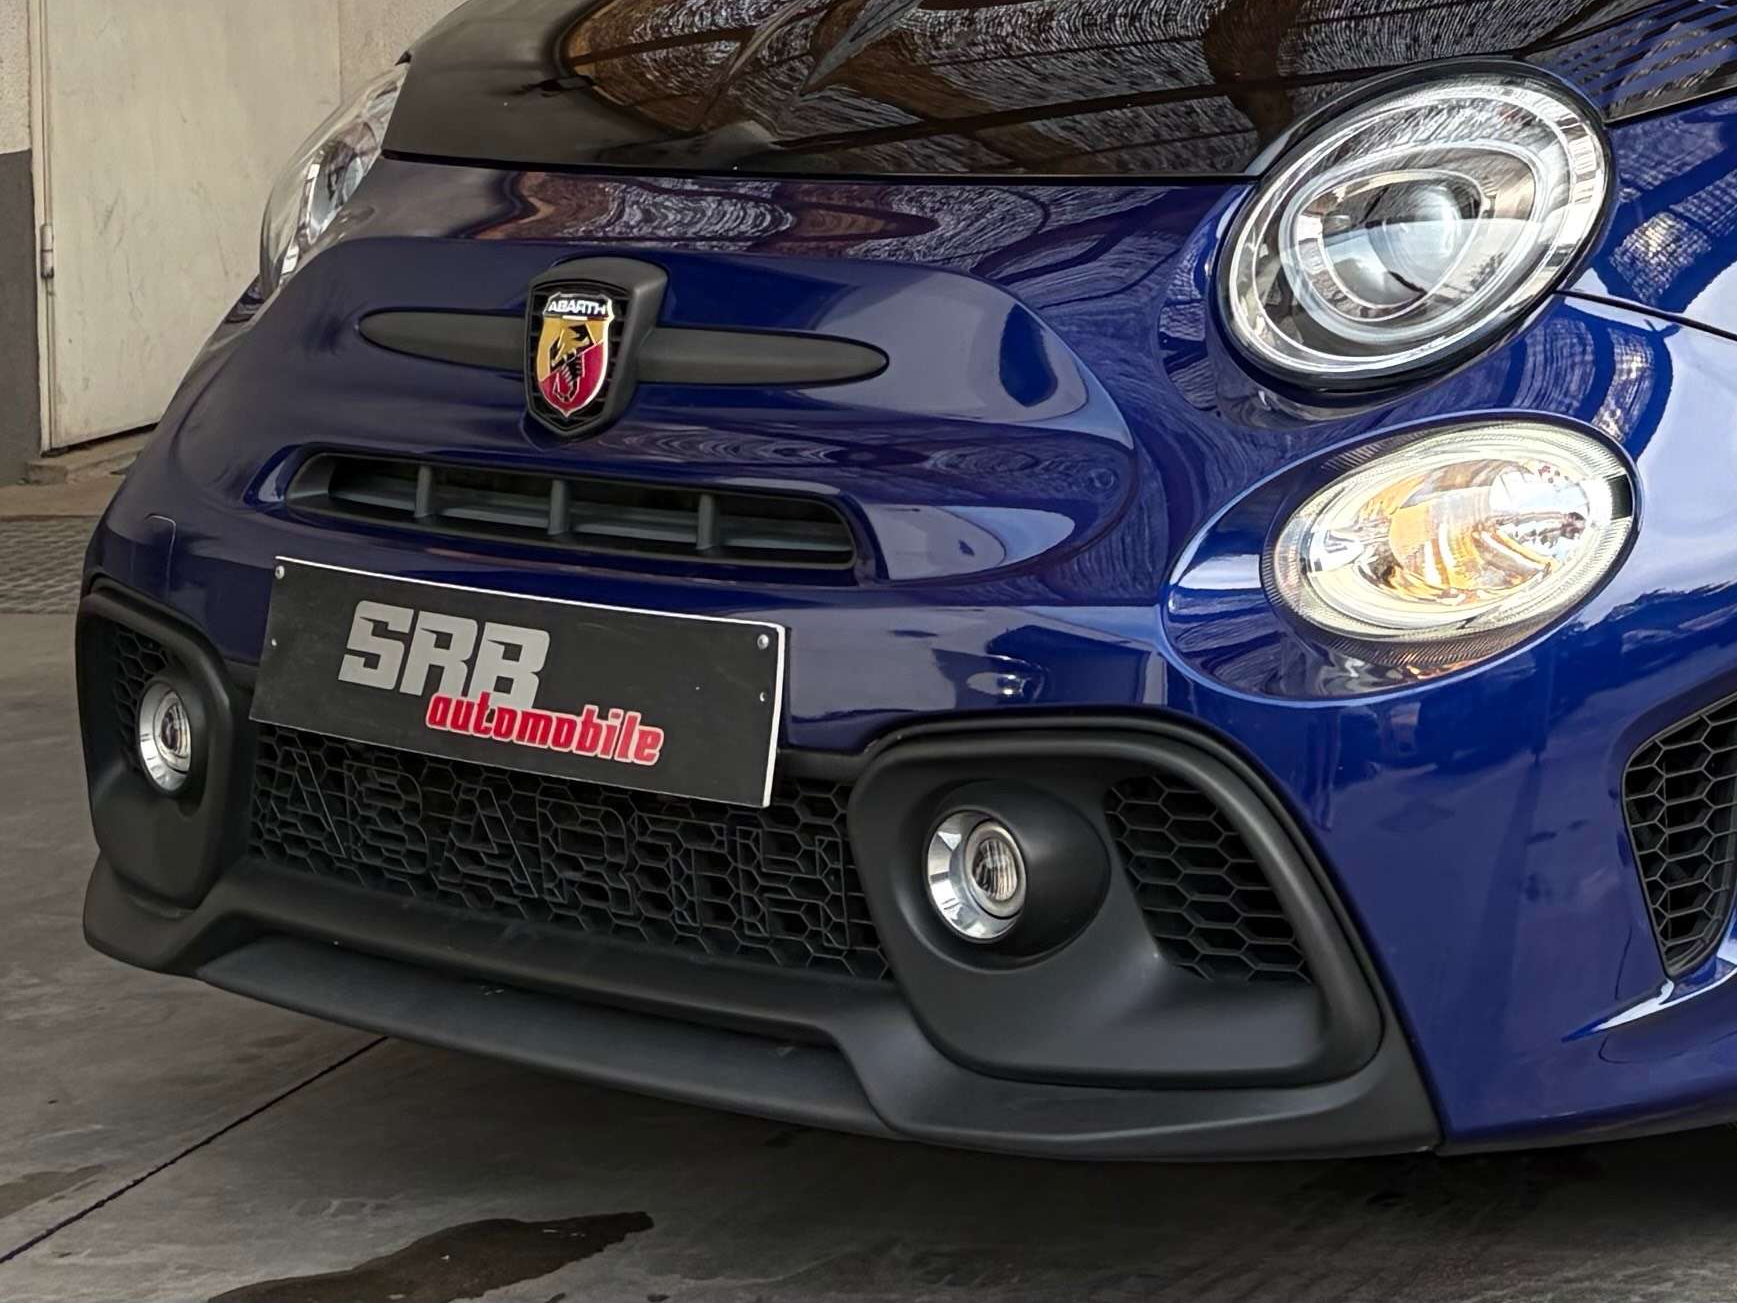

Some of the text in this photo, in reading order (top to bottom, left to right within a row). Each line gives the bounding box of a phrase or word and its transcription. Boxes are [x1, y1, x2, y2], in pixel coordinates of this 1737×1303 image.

[548, 299, 606, 315] ABARTH
[338, 600, 551, 710] SRB
[426, 691, 665, 767] automobile
